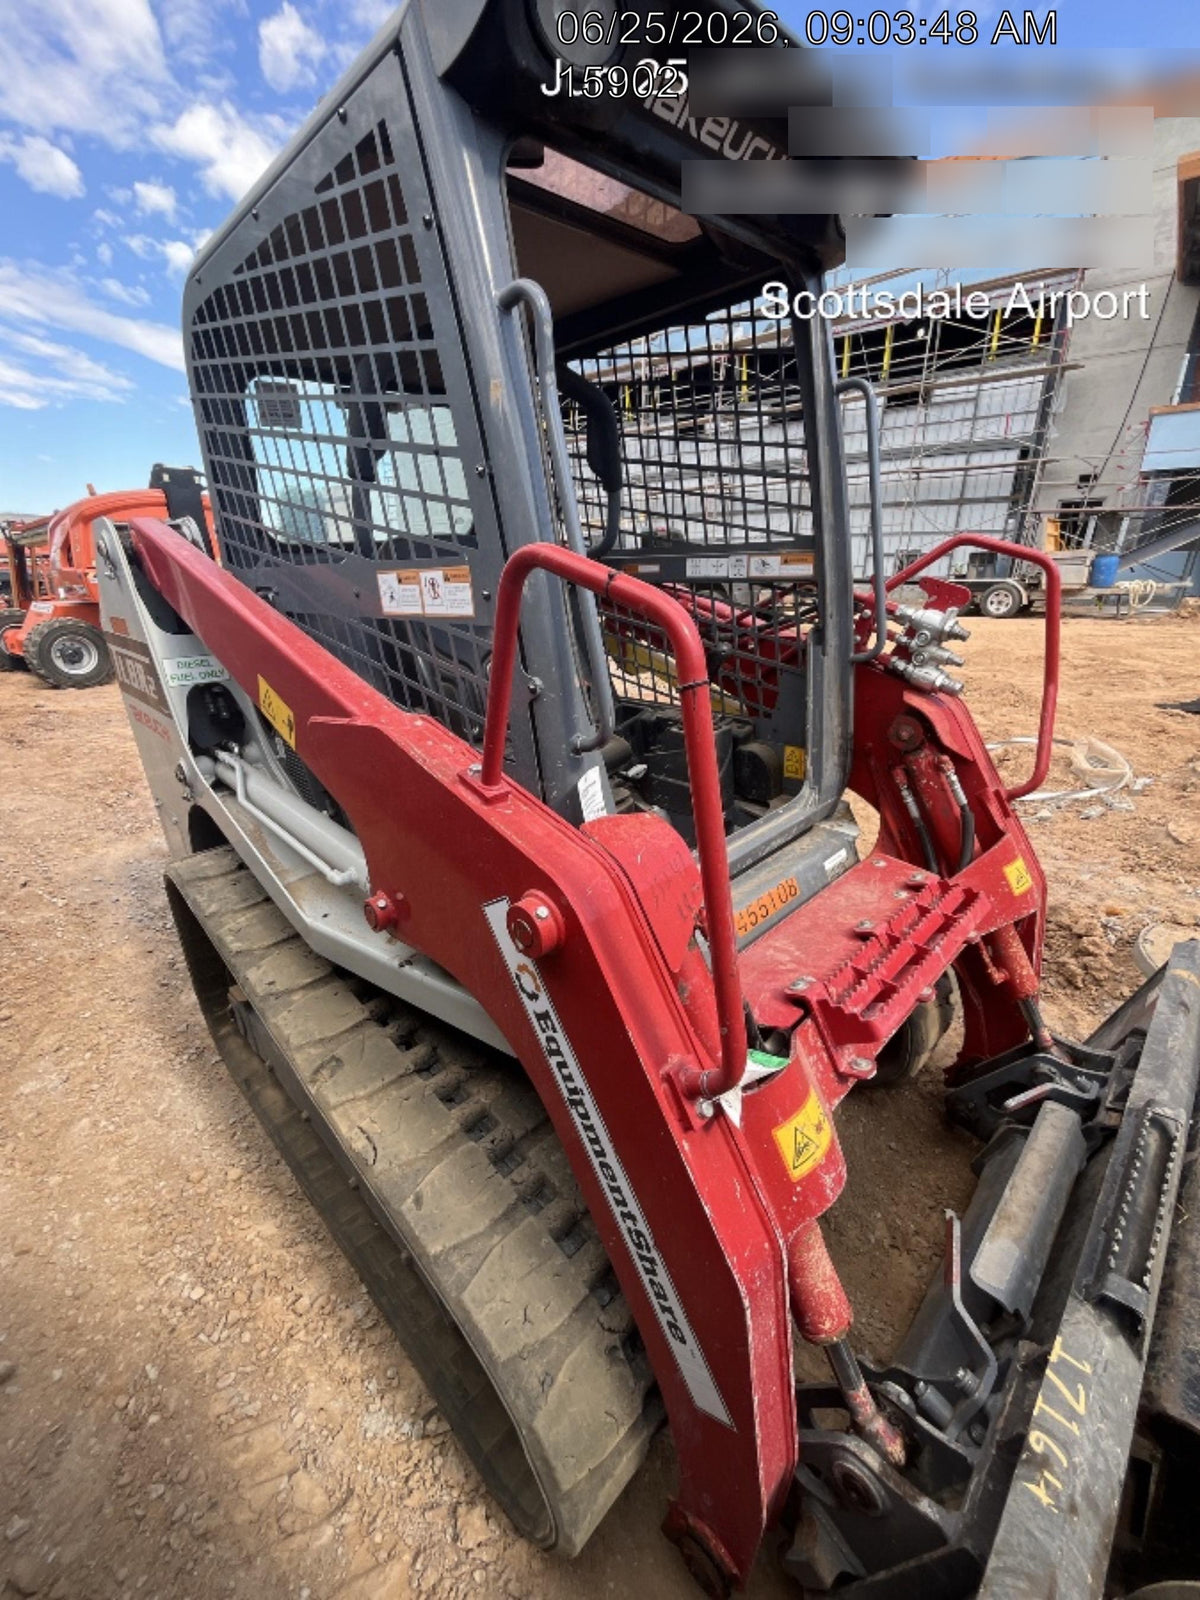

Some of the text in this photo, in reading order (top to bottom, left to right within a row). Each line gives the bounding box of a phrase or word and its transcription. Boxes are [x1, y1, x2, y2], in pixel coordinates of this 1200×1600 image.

[176, 658, 214, 670] DIESEL
[169, 668, 226, 684] FUEL ONLY
[534, 1010, 687, 1346] EquipmentShare
